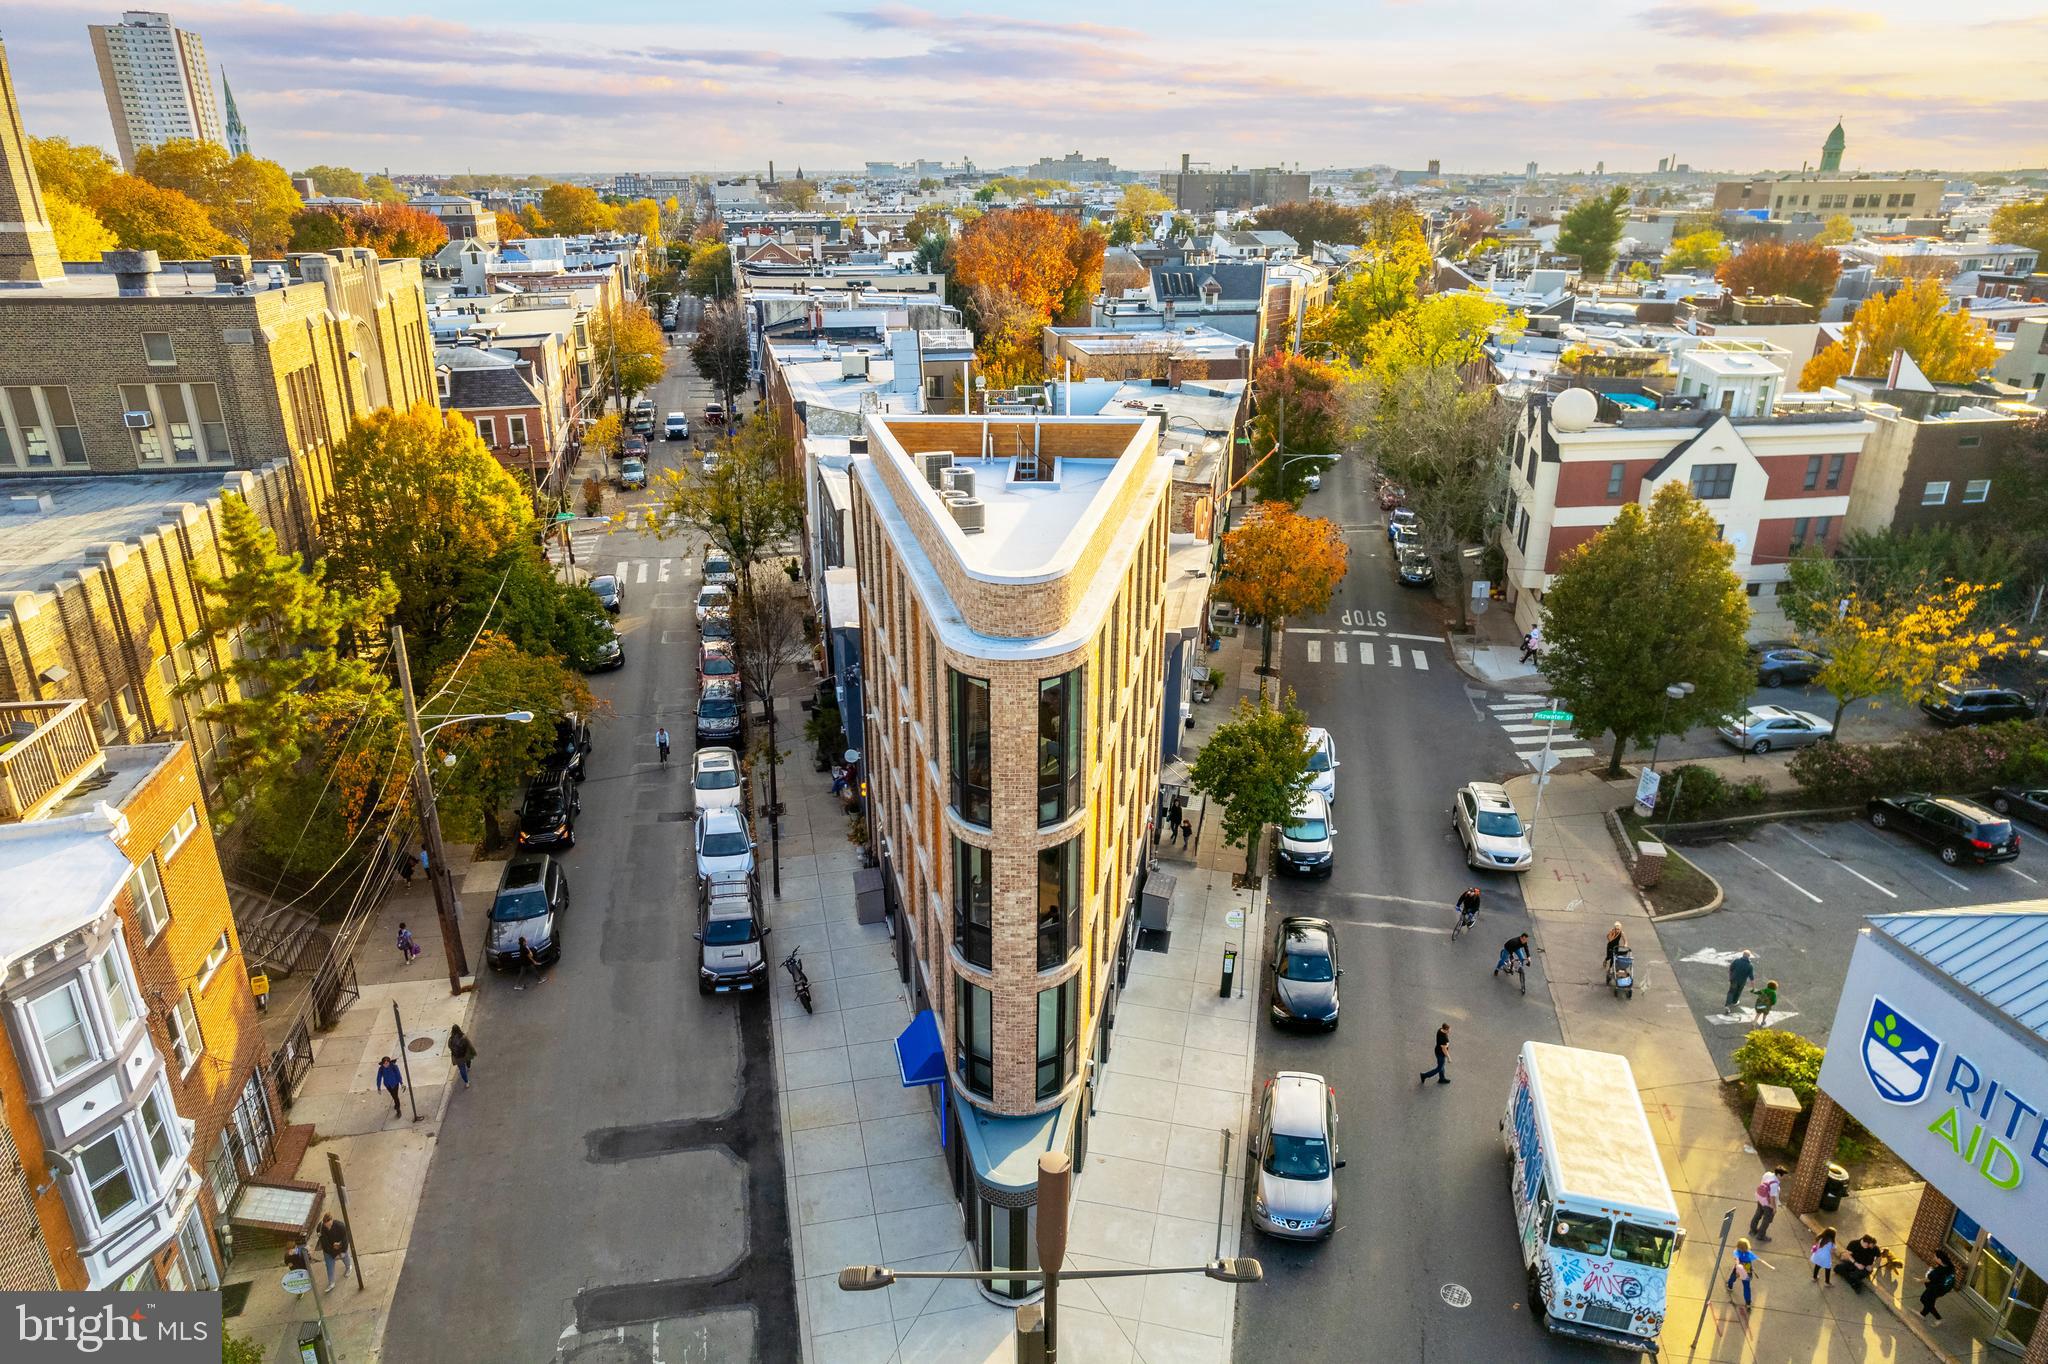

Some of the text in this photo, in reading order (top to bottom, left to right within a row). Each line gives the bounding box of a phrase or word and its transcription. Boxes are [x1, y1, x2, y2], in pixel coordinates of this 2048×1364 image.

[1341, 609, 1387, 627] STOP
[1534, 712, 1564, 720] Fitzwater
[1927, 1106, 2022, 1190] AID
